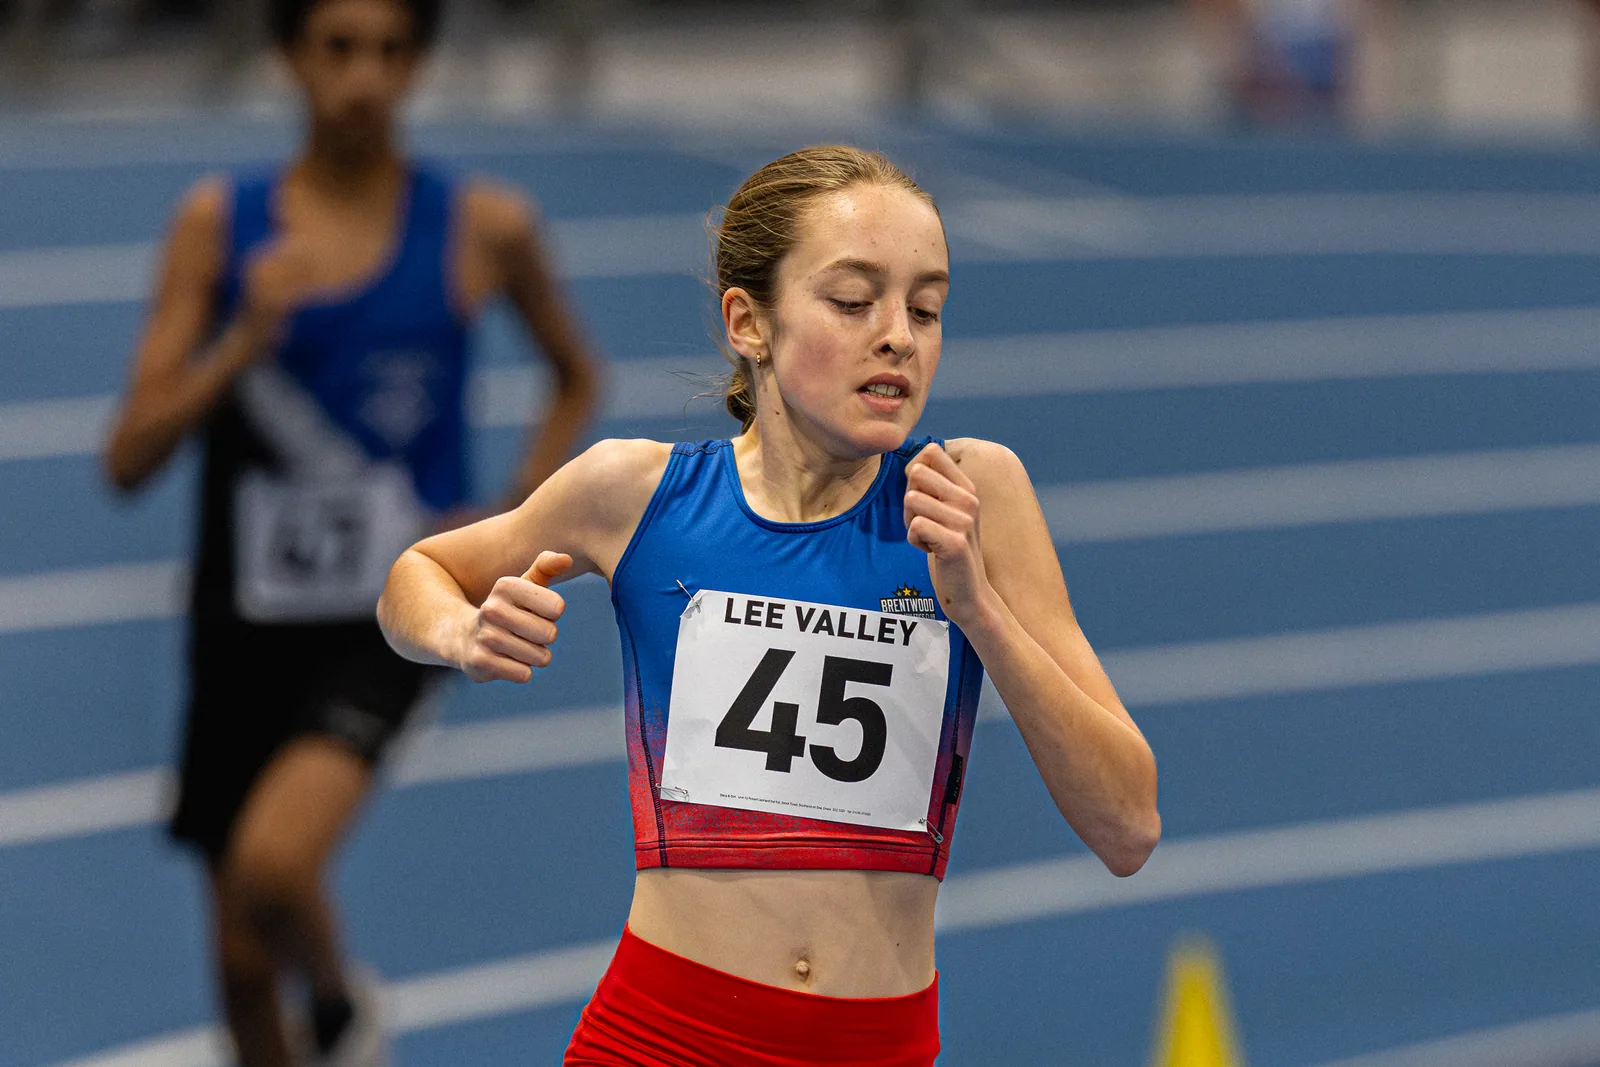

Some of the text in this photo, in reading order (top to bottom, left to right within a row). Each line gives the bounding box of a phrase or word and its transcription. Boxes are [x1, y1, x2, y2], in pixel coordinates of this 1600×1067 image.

[725, 598, 918, 647] LEE VALLEY
[880, 598, 935, 613] BRENTWOOD
[714, 647, 894, 783] 45
